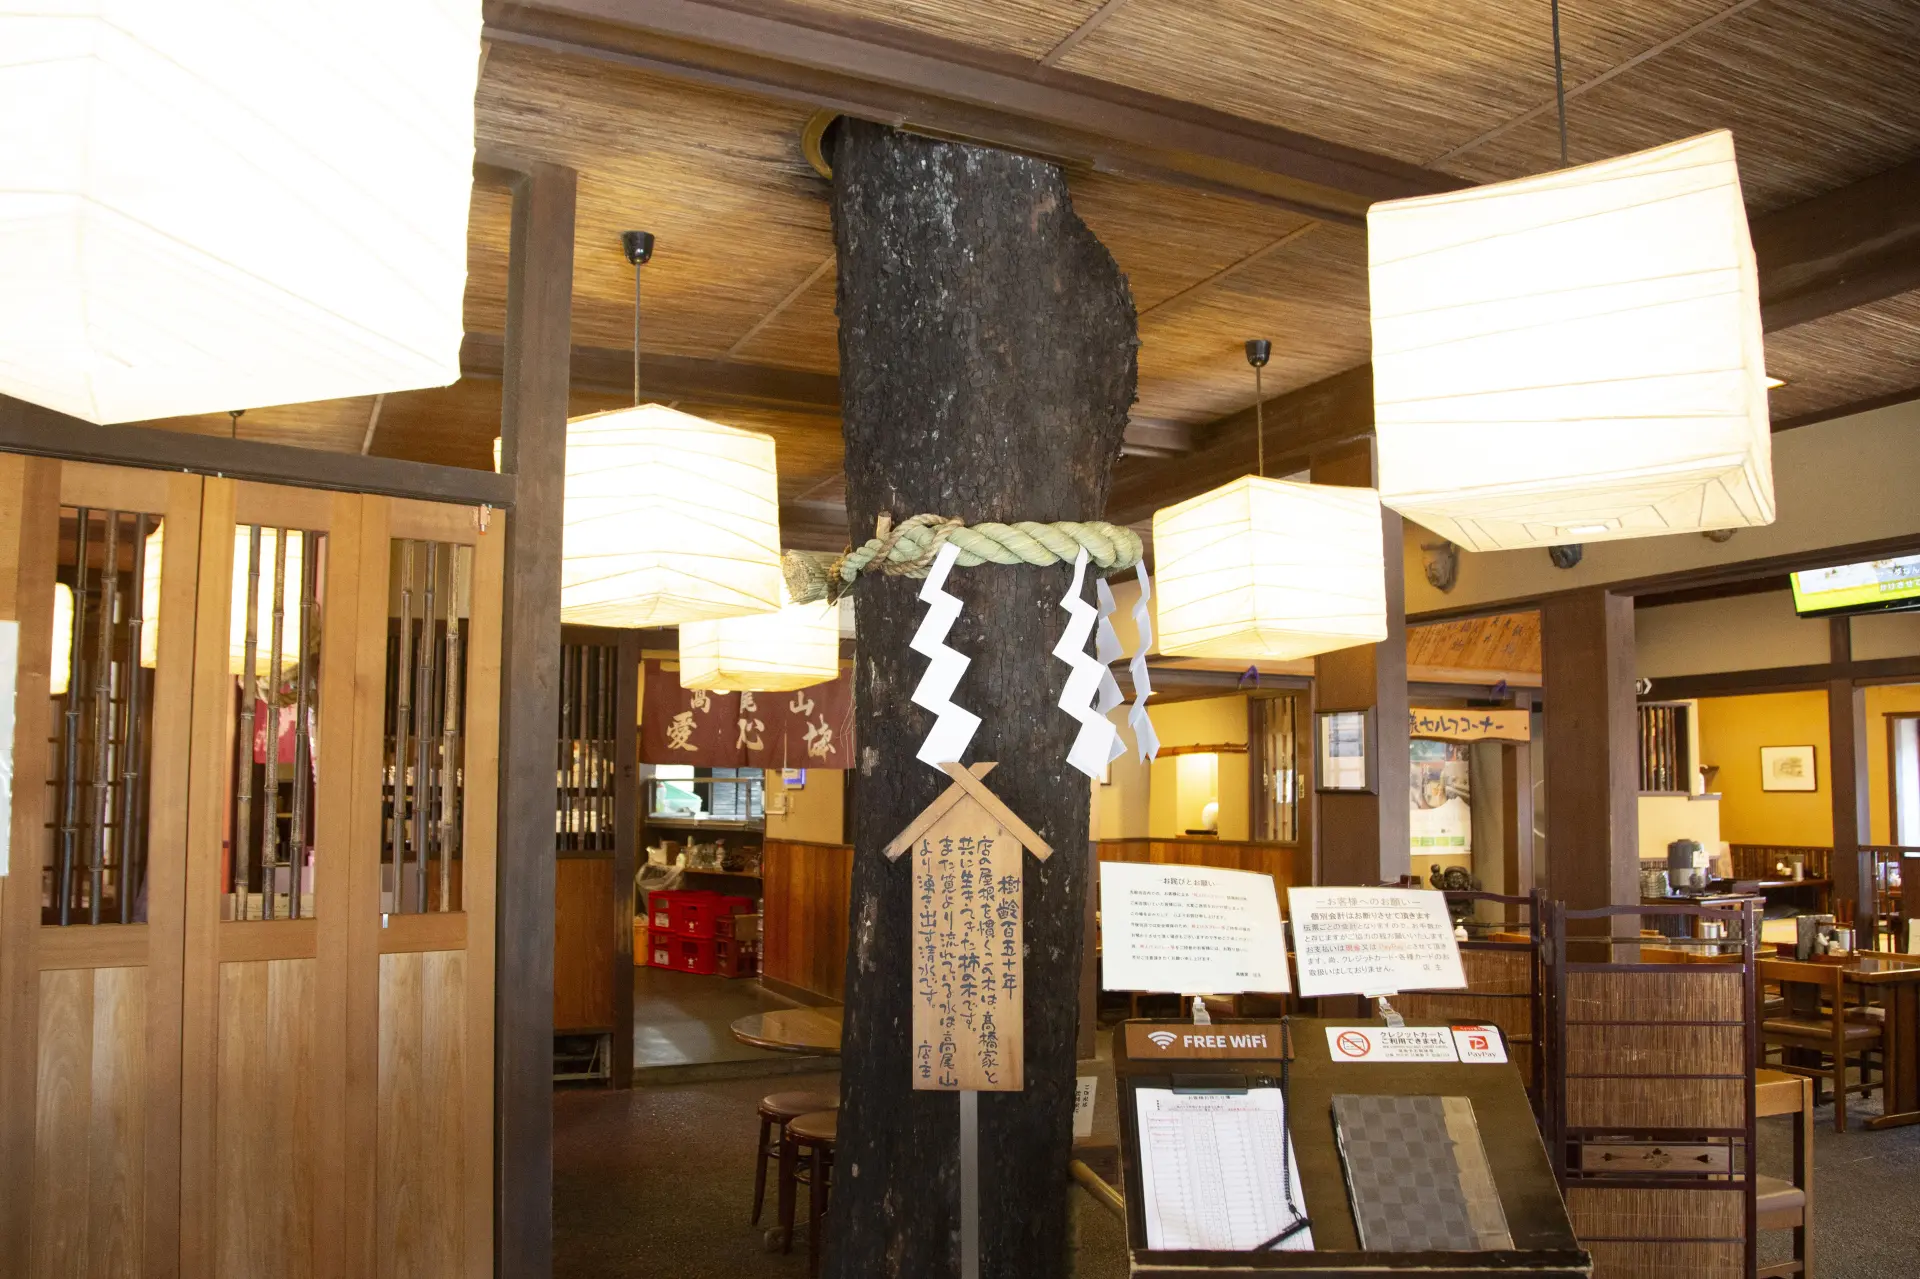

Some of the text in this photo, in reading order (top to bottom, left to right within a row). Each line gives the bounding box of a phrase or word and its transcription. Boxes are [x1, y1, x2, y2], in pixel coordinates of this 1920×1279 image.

[997, 875, 1021, 1001] 樹齢百五十年
[1183, 1034, 1268, 1048] FREE WiFi
[1381, 1037, 1447, 1045] ご利用できません
[917, 1039, 932, 1079] 店主
[1467, 1051, 1498, 1059] PayPay
